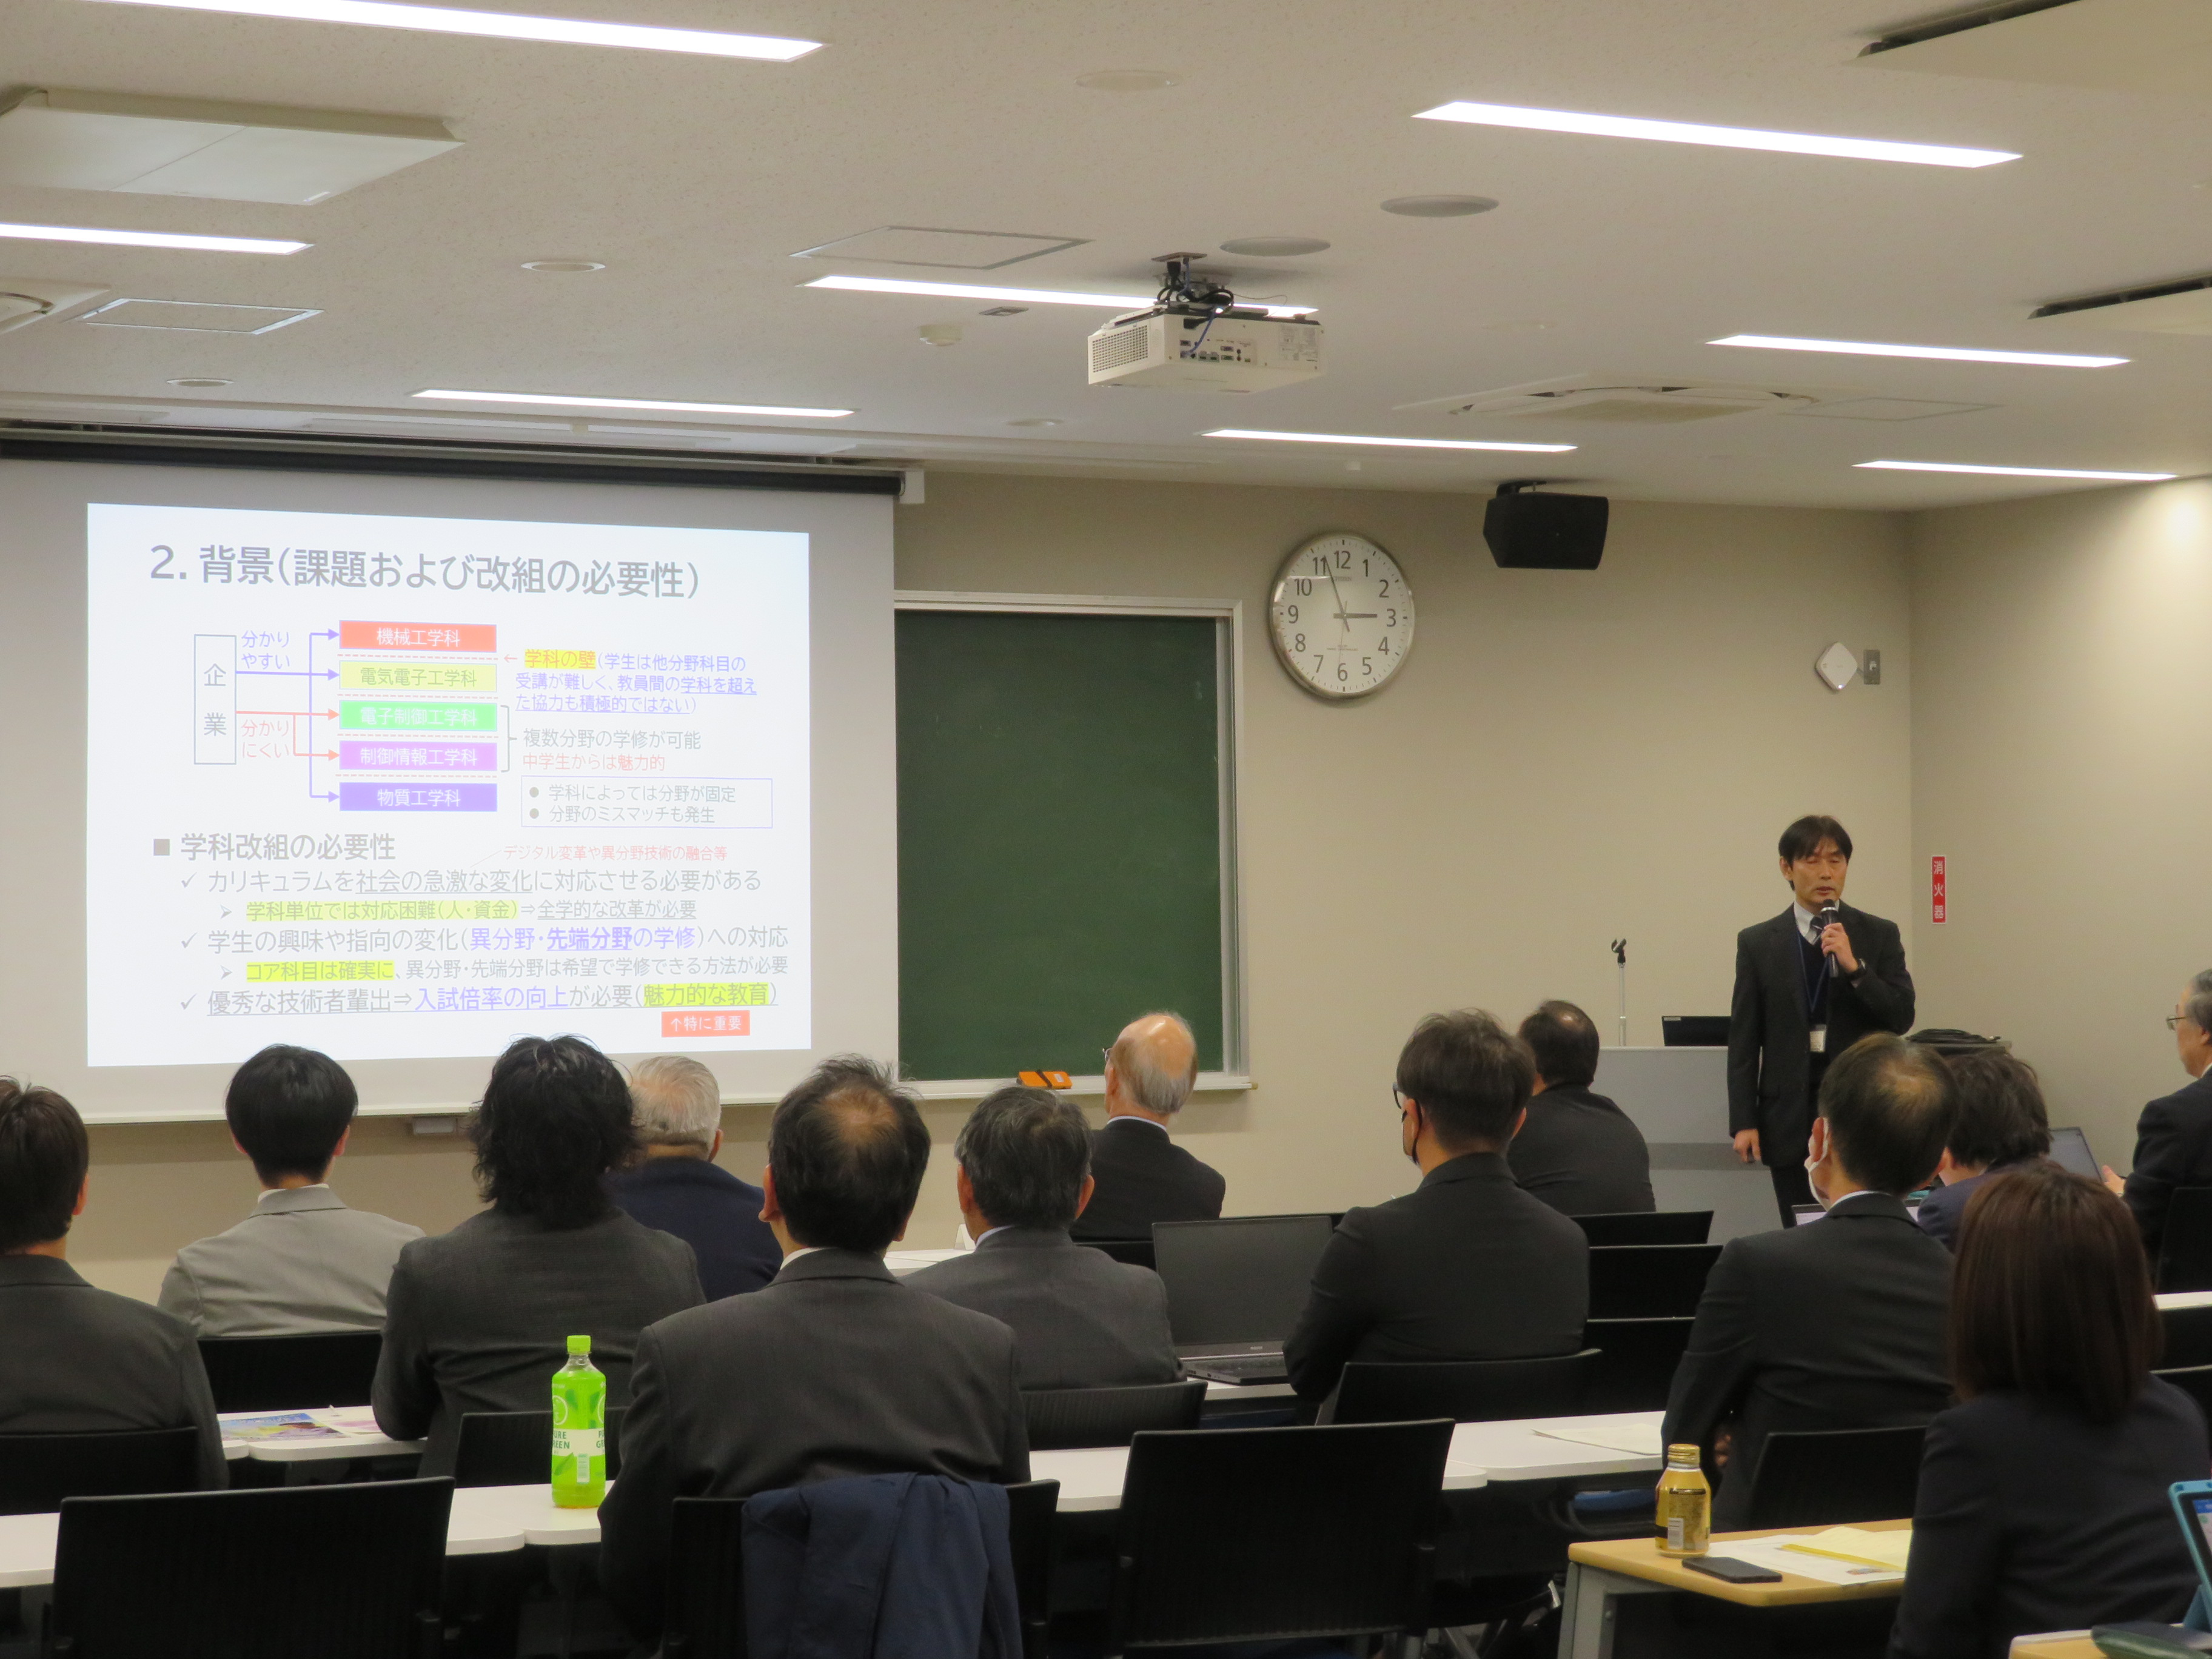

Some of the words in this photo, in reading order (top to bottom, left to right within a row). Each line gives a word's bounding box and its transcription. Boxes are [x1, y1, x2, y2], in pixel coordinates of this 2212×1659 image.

[1313, 556, 1327, 575] 11
[1334, 551, 1351, 569] 12
[1362, 559, 1369, 577] 1
[199, 545, 699, 598] 背景(課題および改組の必要性)
[1294, 578, 1312, 596] 10
[1379, 579, 1389, 598] 2
[1288, 605, 1299, 624] 9
[1386, 608, 1396, 627] 3
[241, 630, 290, 648] 分かり
[377, 627, 460, 648] 機械工学科
[1295, 633, 1306, 652] 8
[1378, 636, 1390, 655] 4
[241, 653, 290, 669] やすい
[1313, 654, 1324, 673] 7
[1362, 657, 1372, 675] 5
[360, 667, 477, 687] 電気電子工学科
[1338, 662, 1348, 682] 6
[515, 672, 757, 693] 受講が難しく、教員間の学科を超え
[360, 708, 477, 727] 電子制御工学科
[241, 719, 290, 737] 分かり
[523, 728, 701, 749] 複数分野の学修が可能
[241, 742, 290, 759] にくい
[360, 747, 478, 767] 制御情報工学科
[523, 754, 665, 771] 中学生からは魅力的
[377, 788, 461, 807] 物質工学科
[549, 785, 736, 803] 学科によっては分野が固定
[549, 805, 716, 823] 分野のミスマッチも発生
[181, 833, 396, 861] 学科改組の必要性
[503, 845, 728, 862] デジタル変革や異分野技術の融合等
[208, 868, 761, 893] カリキュラムを社会の急激な変化に対応させる必要がある
[1934, 860, 1944, 919] 消火器
